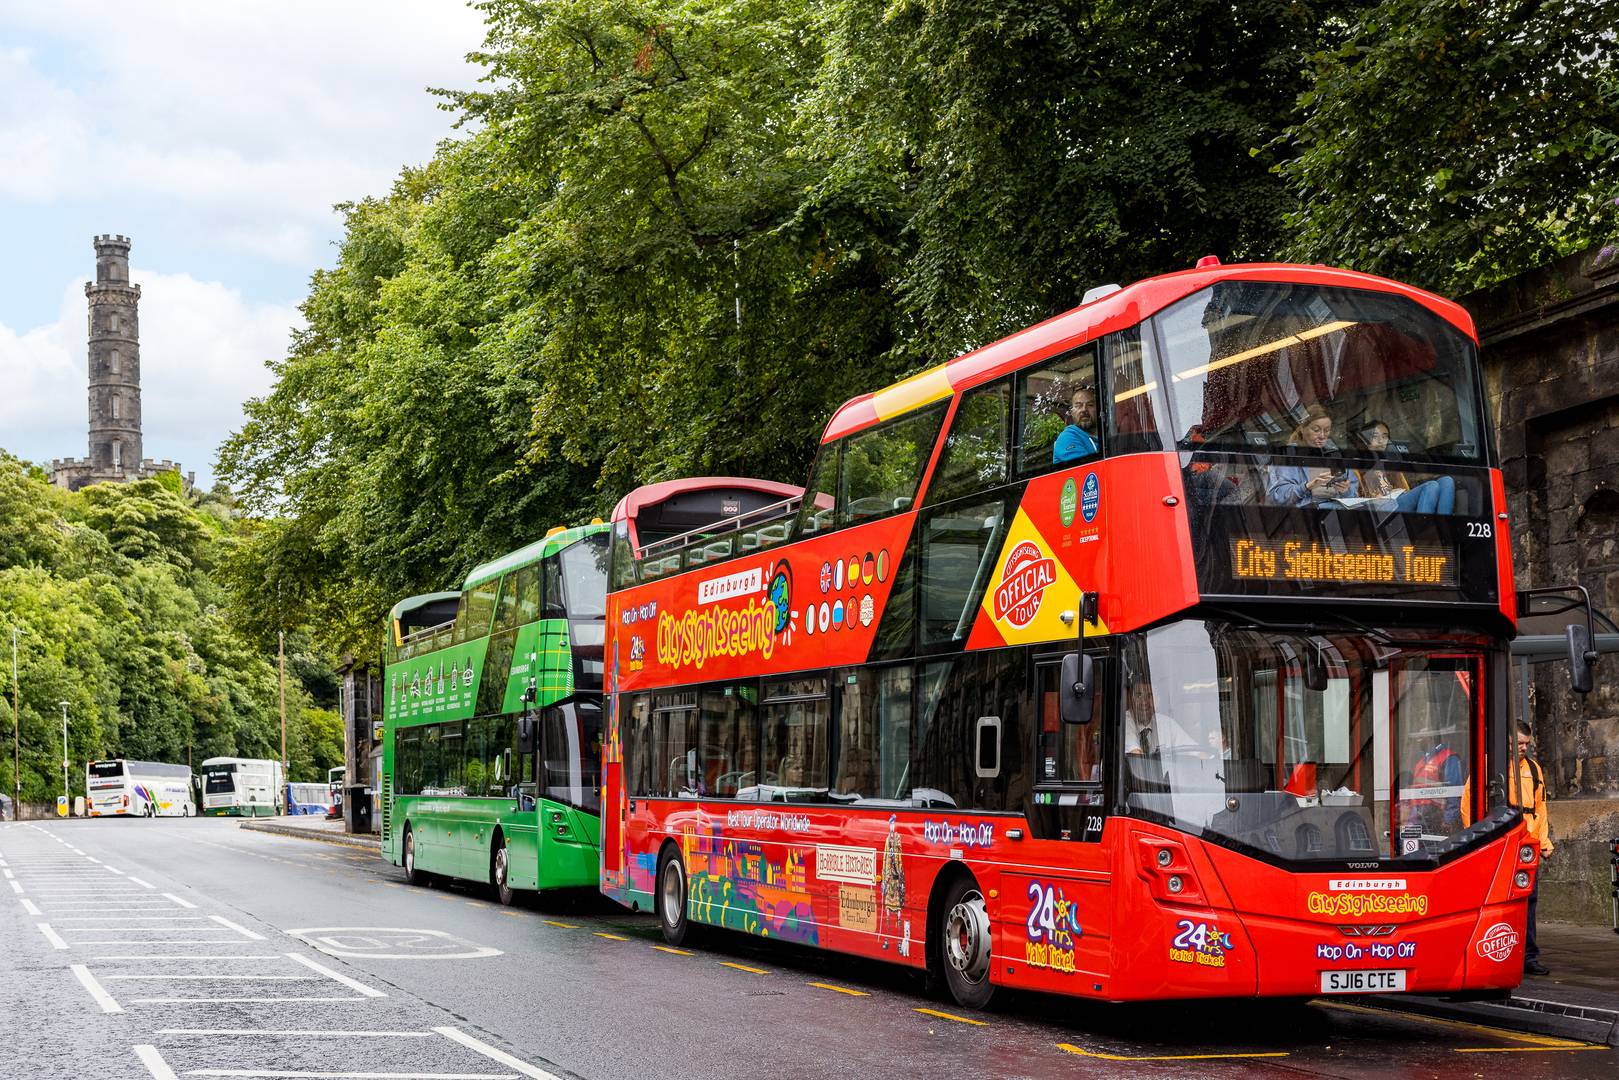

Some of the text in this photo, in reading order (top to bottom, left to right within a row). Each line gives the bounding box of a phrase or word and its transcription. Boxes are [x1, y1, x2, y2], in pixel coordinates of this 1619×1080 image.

[1468, 523, 1492, 538] 228
[1236, 540, 1446, 582] City Sightseeing Tour
[703, 573, 756, 598] Edinburgh
[1000, 562, 1053, 612] OFFICIAL
[1015, 595, 1040, 622] TOUR
[657, 598, 776, 670] CitySightseeing
[728, 810, 811, 832] Best Tour Operator Worldwide
[924, 821, 940, 844] Hop
[942, 821, 953, 843] On
[960, 823, 976, 846] Hop
[978, 823, 993, 846] Off
[1087, 816, 1102, 831] 228
[840, 890, 876, 917] Edinburgh
[1027, 882, 1056, 941] 24
[1308, 891, 1428, 916] CitySightseeing
[1174, 920, 1206, 951] 24
[1483, 934, 1518, 953] OFFICIAL
[1026, 942, 1076, 972] Valid Ticket
[1170, 948, 1225, 967] Valid Ticket
[1318, 945, 1342, 960] Hop
[1345, 944, 1362, 959] On
[1371, 944, 1395, 959] Hop
[1397, 942, 1416, 958] Off
[1496, 947, 1511, 959] TOUR
[1330, 972, 1396, 989] SJ16 CTE
